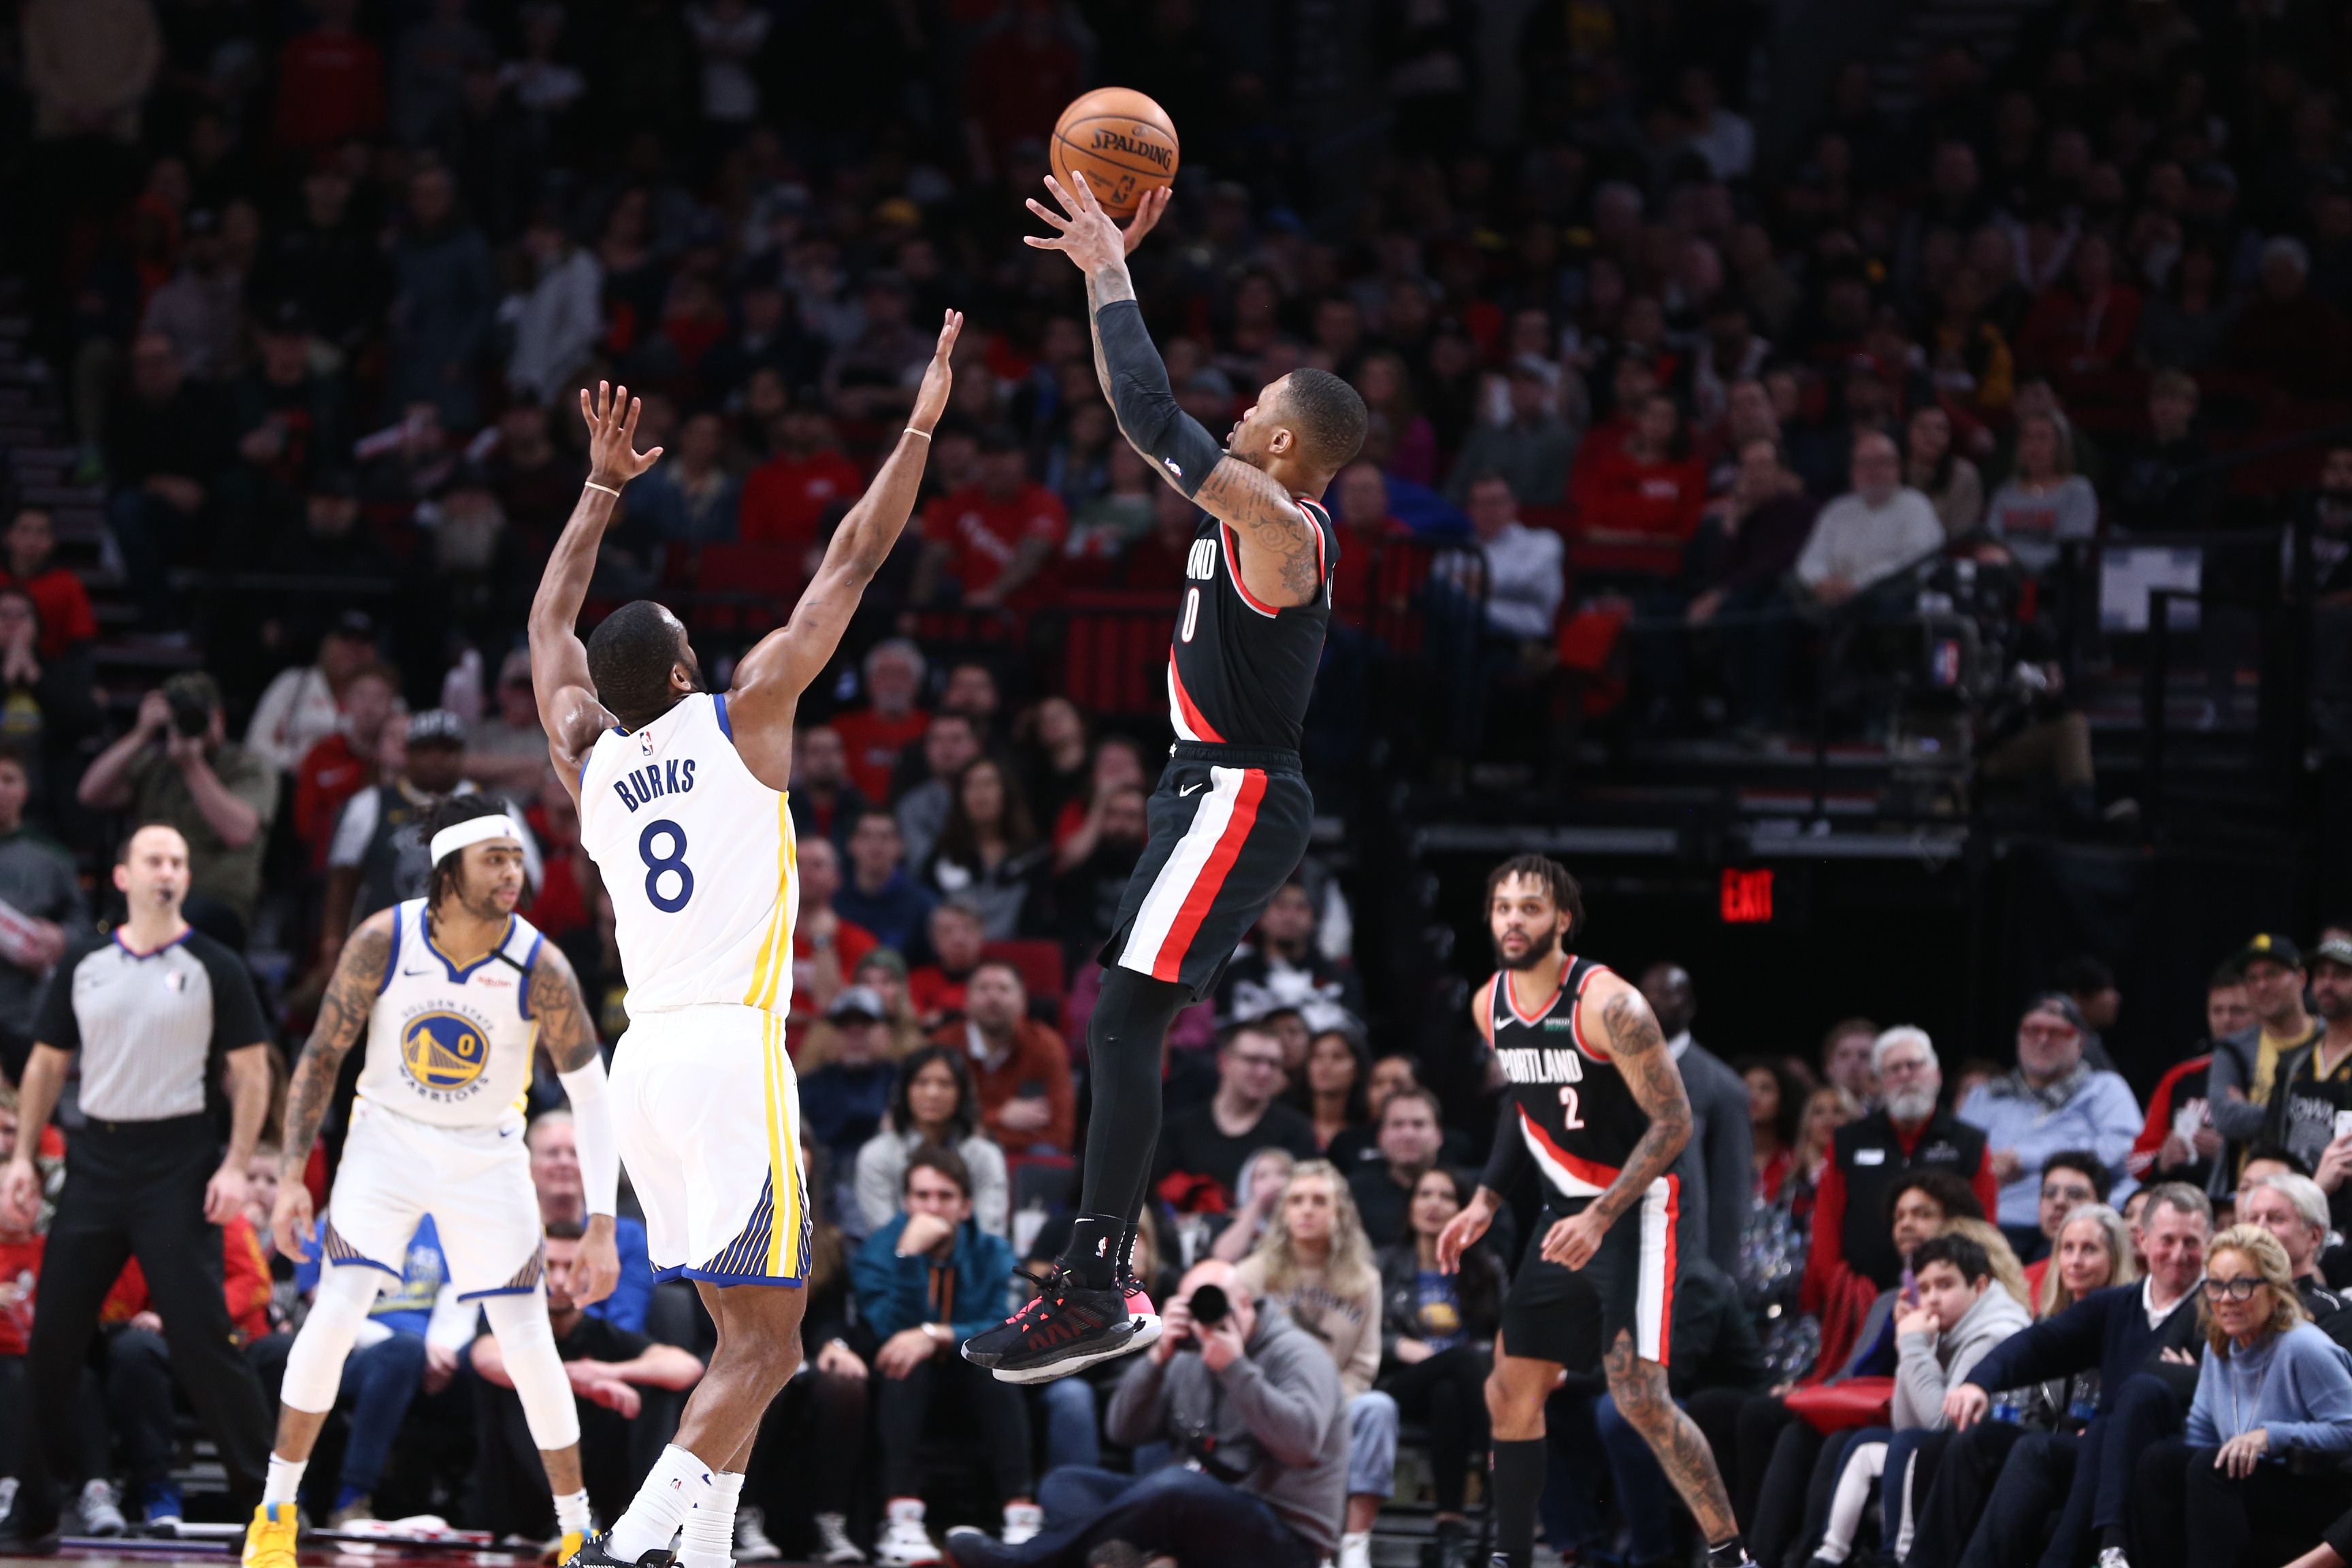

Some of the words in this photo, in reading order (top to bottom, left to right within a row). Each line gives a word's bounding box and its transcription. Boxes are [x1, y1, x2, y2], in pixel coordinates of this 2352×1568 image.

[1092, 128, 1172, 171] SPALDING
[1181, 587, 1200, 643] 0
[613, 759, 696, 813] BURKS
[639, 819, 694, 913] 8
[1721, 868, 1773, 922] EXIT
[457, 1034, 476, 1057] 0
[399, 1065, 489, 1102] WARRIORS
[1558, 1086, 1585, 1130] 2
